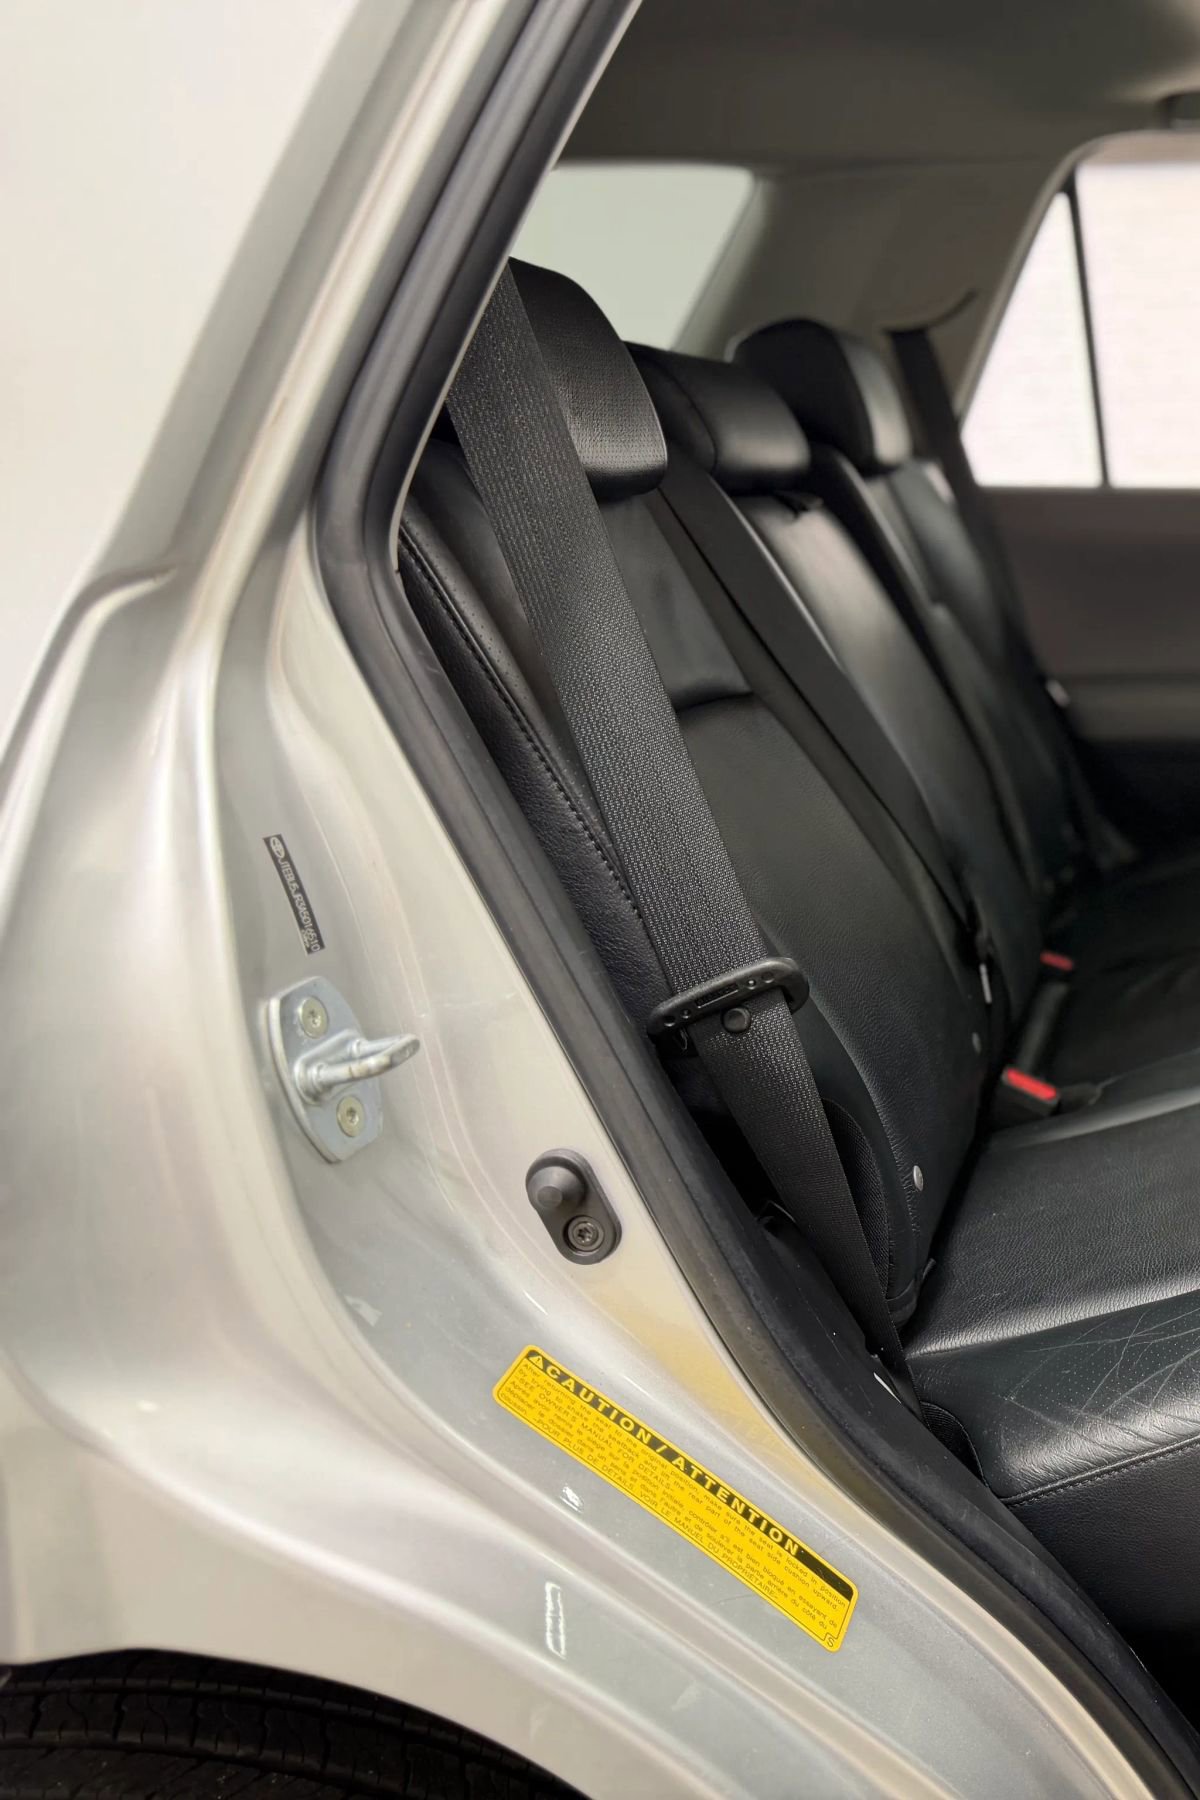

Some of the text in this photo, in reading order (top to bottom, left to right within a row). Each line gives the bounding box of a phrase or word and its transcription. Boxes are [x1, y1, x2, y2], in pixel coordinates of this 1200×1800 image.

[517, 1368, 528, 1378] by
[530, 1378, 552, 1396] trying
[554, 1395, 564, 1404] to
[566, 1403, 589, 1422] shake
[592, 1421, 605, 1432] the
[607, 1432, 640, 1458] seatback
[644, 1459, 658, 1471] and
[673, 1480, 685, 1490] the
[688, 1491, 703, 1505] rear
[704, 1504, 720, 1518] part
[723, 1517, 731, 1525] of
[733, 1525, 746, 1536] the
[748, 1538, 764, 1551] seat
[766, 1551, 781, 1565] side
[783, 1565, 810, 1588] cushion
[522, 1362, 541, 1377] After
[543, 1377, 576, 1404] returning
[579, 1404, 592, 1415] the
[595, 1415, 611, 1429] seat
[614, 1429, 623, 1437] to
[625, 1437, 638, 1448] the
[640, 1447, 667, 1470] original
[702, 1494, 723, 1510] make
[724, 1511, 741, 1525] sure
[743, 1524, 756, 1536] the
[758, 1537, 774, 1550] seat
[784, 1557, 808, 1577] locked
[809, 1577, 818, 1585] in
[819, 1584, 847, 1607] position
[544, 1363, 800, 1555] CAUTION / ATTENTION
[562, 1436, 584, 1455] PLUS
[586, 1453, 599, 1465] DE
[638, 1491, 658, 1508] VOIR
[660, 1507, 671, 1517] LE
[673, 1516, 705, 1542] MANUEL
[707, 1542, 719, 1553] DU
[580, 1422, 614, 1448] MANUAL
[616, 1447, 635, 1463] FOR
[632, 1468, 660, 1491] position
[687, 1509, 718, 1533] contrôler
[731, 1542, 744, 1553] est
[744, 1553, 761, 1567] bien
[761, 1566, 785, 1586] bloqué
[786, 1585, 796, 1595] en
[796, 1595, 827, 1620] essayant
[827, 1618, 838, 1628] de
[639, 1483, 657, 1498] dans
[683, 1515, 691, 1523] et
[693, 1523, 703, 1532] de
[735, 1555, 743, 1563] la
[790, 1598, 800, 1607] du
[800, 1606, 817, 1620] côté
[817, 1620, 828, 1629] du
